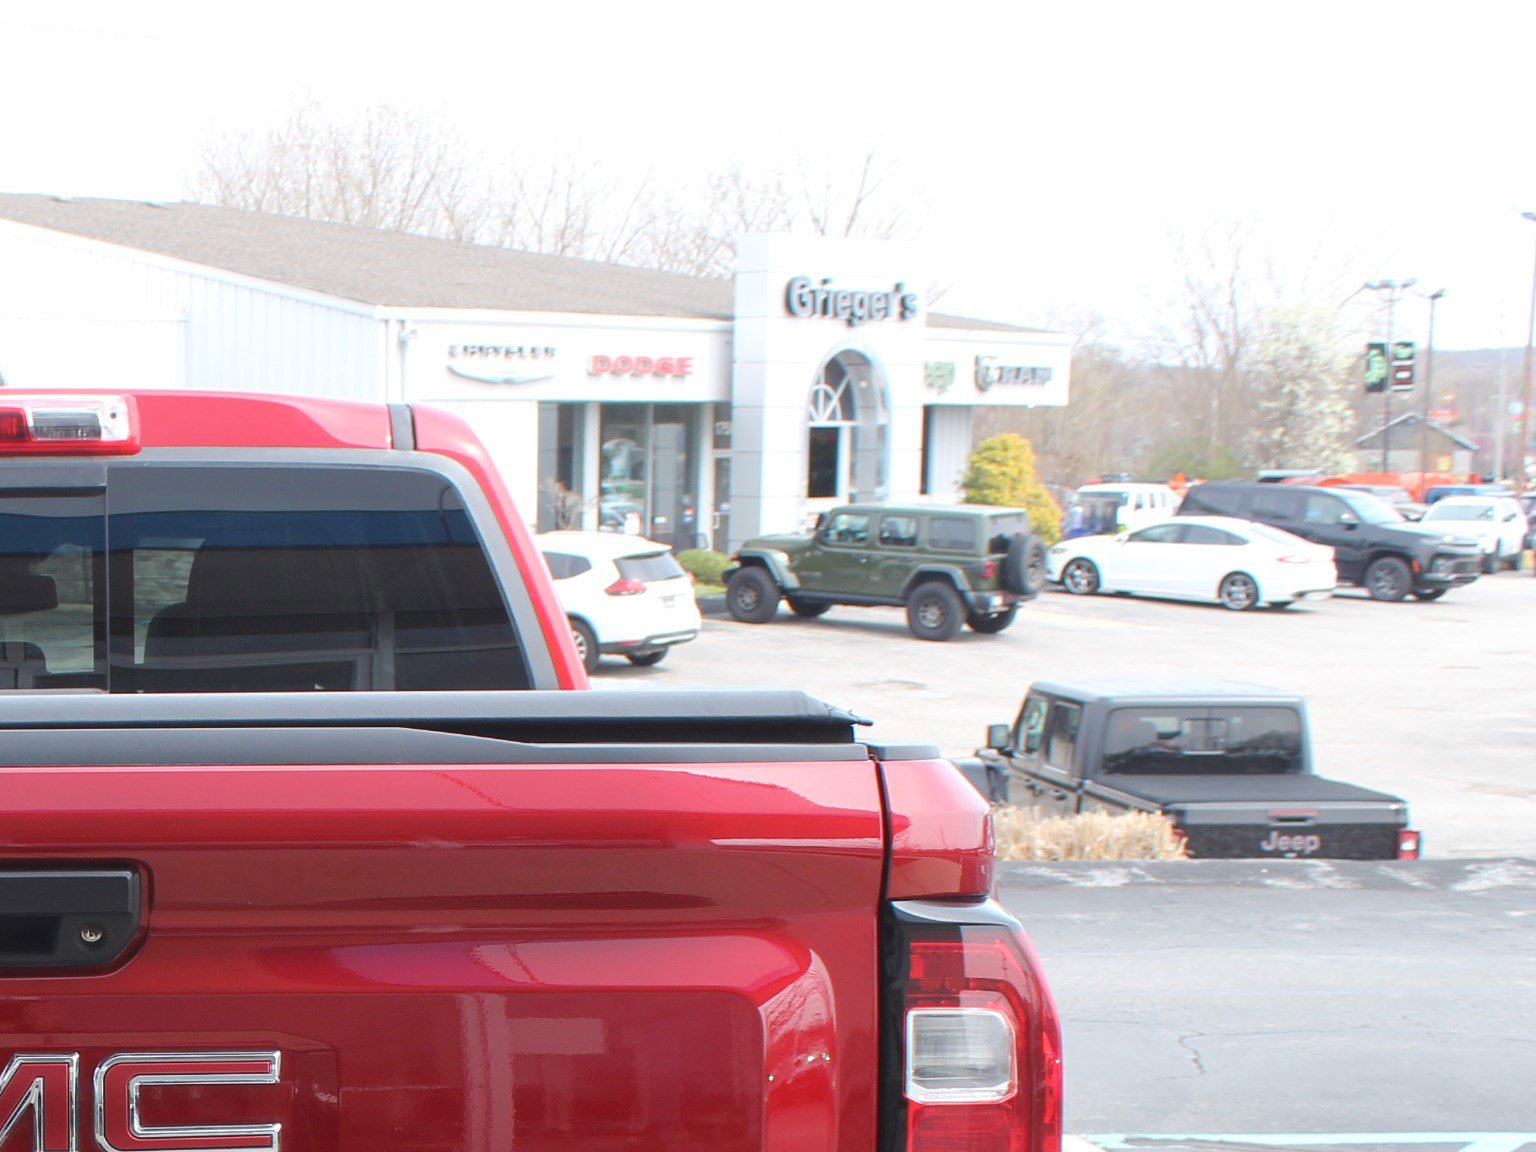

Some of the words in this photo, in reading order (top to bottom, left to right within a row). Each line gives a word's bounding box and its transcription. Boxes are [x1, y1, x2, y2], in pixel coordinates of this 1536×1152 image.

[785, 275, 918, 328] Grieger's
[588, 355, 694, 376] DODGE
[1260, 830, 1321, 854] Jeep
